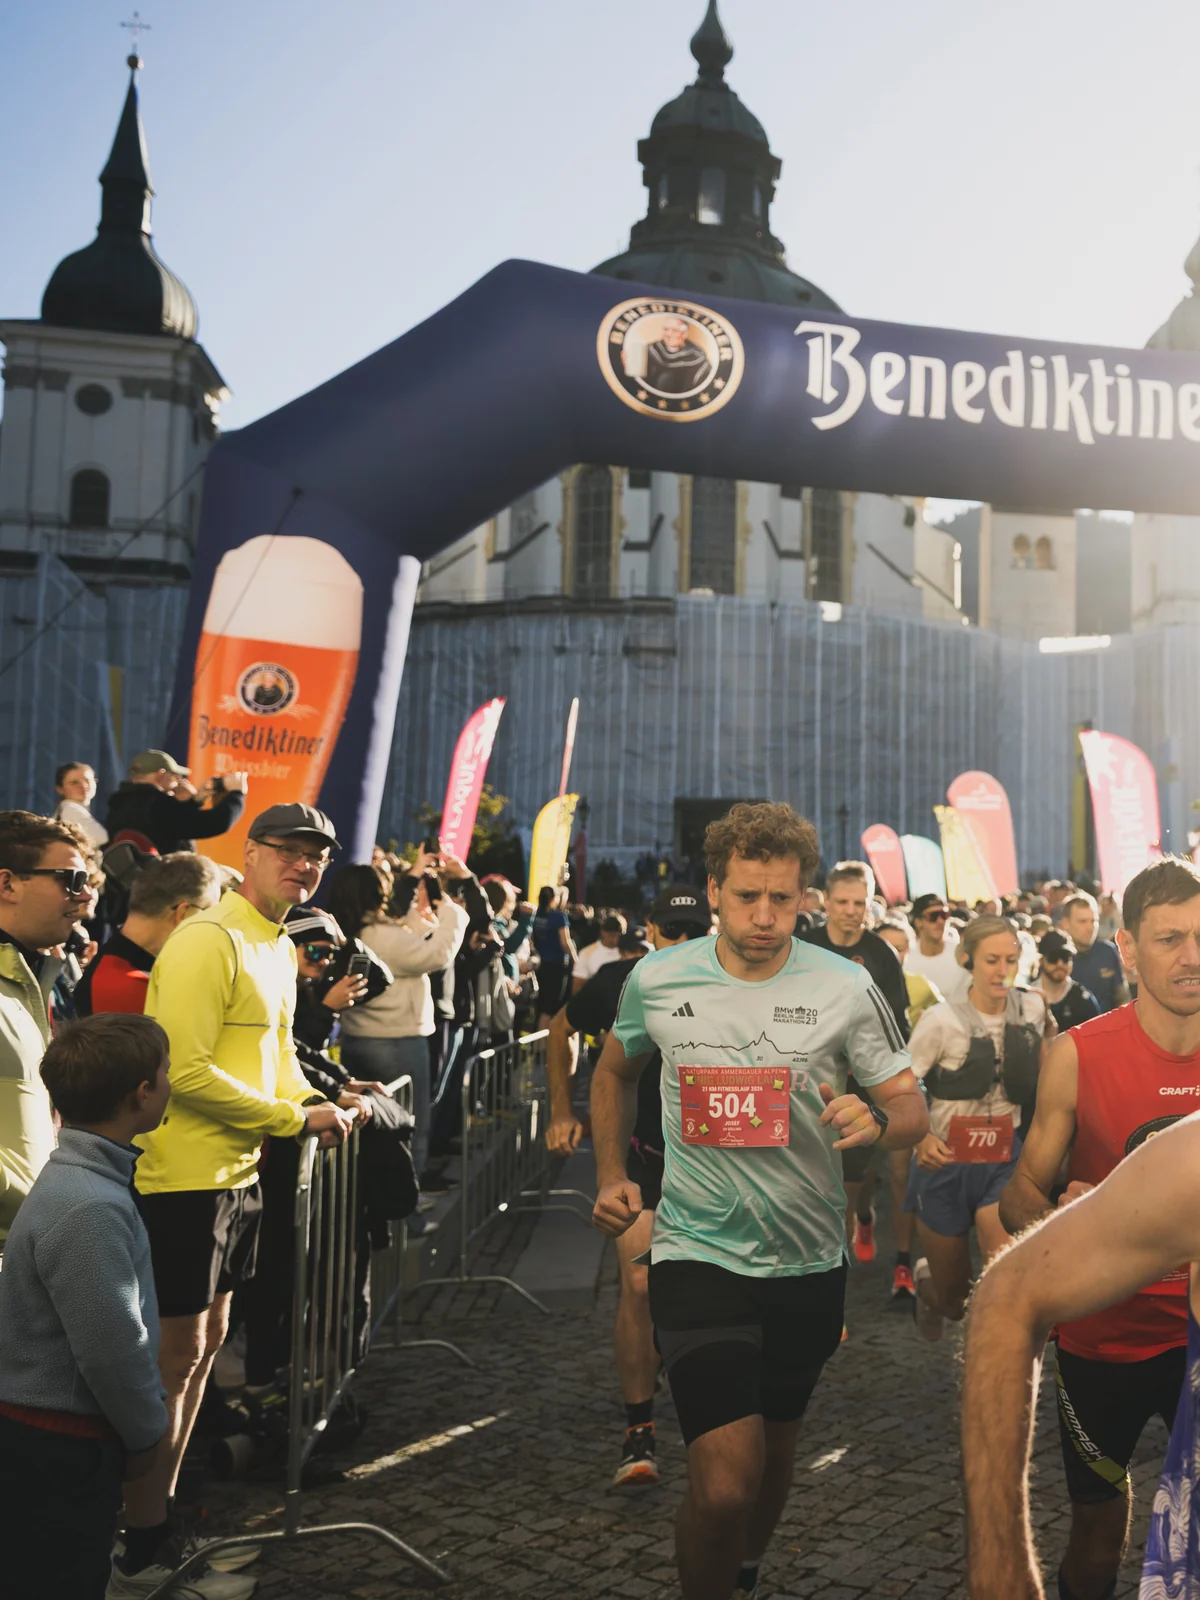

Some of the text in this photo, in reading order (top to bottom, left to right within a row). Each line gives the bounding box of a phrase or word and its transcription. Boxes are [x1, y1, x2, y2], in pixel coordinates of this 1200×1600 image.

[197, 714, 323, 756] Benediktiner
[774, 1006, 794, 1015] BMW
[805, 1008, 818, 1017] 20
[805, 1017, 818, 1025] 23
[716, 1075, 754, 1085] LUDWIG
[1159, 1087, 1196, 1096] CRAFT
[708, 1093, 757, 1118] 504
[968, 1131, 997, 1147] 770
[1059, 1387, 1107, 1461] SMMASH
